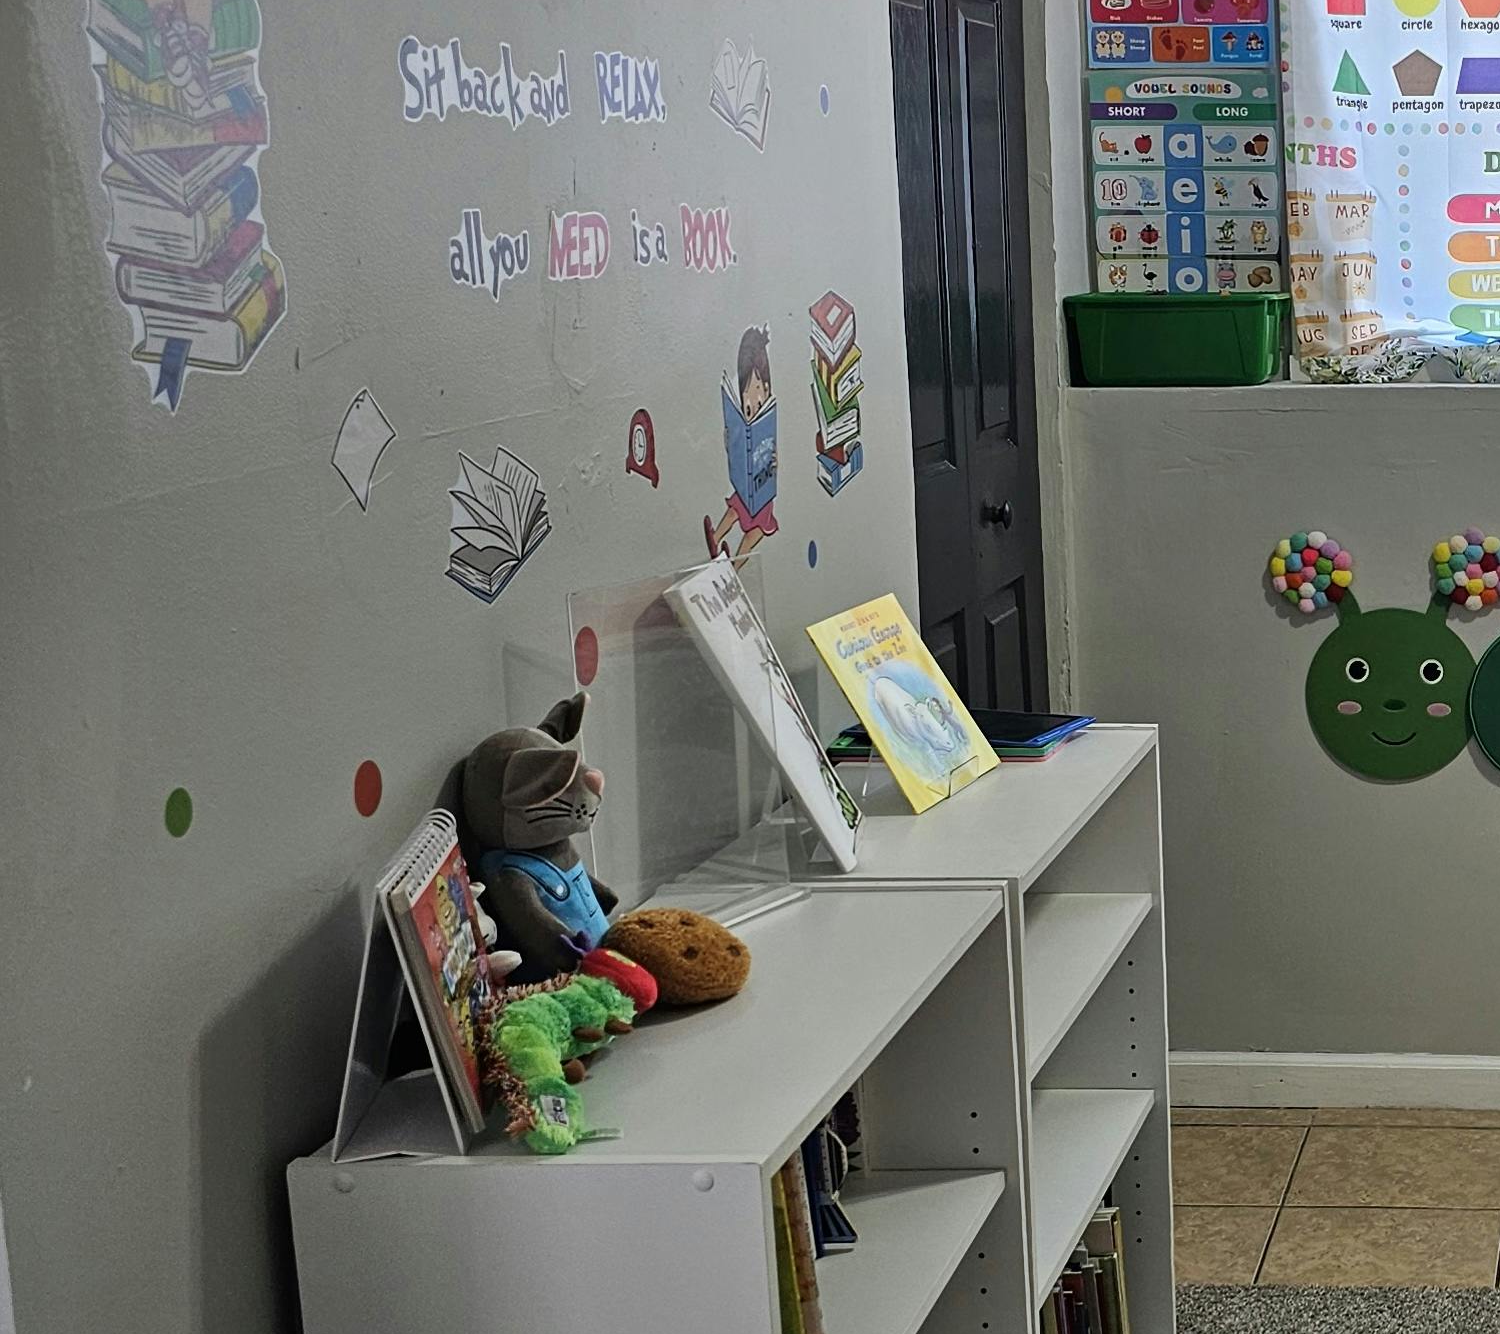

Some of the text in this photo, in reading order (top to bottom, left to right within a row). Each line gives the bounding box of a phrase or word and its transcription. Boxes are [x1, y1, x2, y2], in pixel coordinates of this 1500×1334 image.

[1401, 18, 1433, 30] circle
[400, 38, 446, 119] Sit
[450, 39, 525, 129] back
[529, 51, 570, 125] and
[1182, 82, 1232, 95] SOUNDS
[1108, 106, 1147, 117] SHORT
[1215, 106, 1249, 117] LONG
[1392, 98, 1444, 114] pentagon
[1168, 133, 1196, 159] a
[1172, 178, 1199, 204] e
[1180, 216, 1192, 254] i
[450, 210, 485, 286] all
[489, 231, 529, 300] you
[550, 212, 610, 279] NEED
[631, 210, 650, 264] is
[655, 225, 668, 263] a
[1342, 262, 1373, 280] JUN
